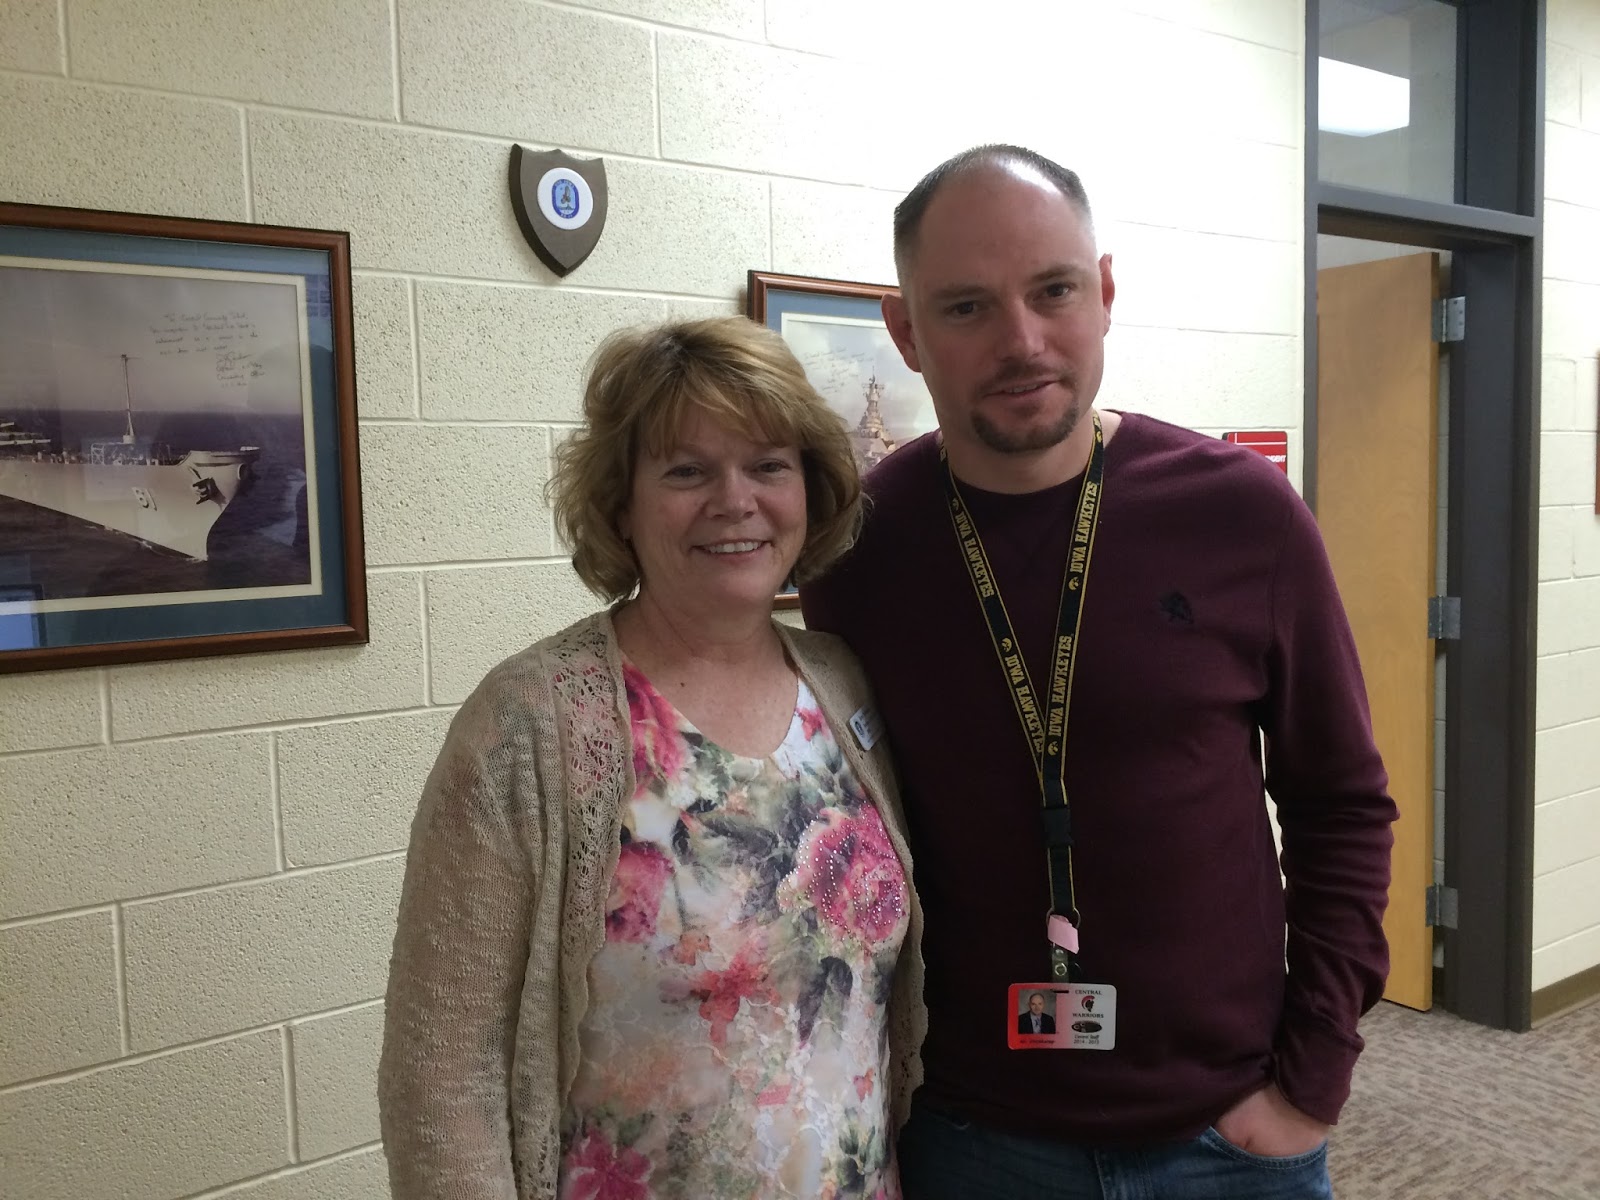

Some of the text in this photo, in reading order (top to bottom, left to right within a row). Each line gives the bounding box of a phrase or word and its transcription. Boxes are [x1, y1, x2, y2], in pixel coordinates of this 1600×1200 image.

[955, 511, 995, 598] IOWA HAWKEYES
[1070, 481, 1097, 573] IOWA HAWKEYES
[1005, 654, 1025, 685] IOWA
[1048, 635, 1072, 737] IOWA HAWKEYES
